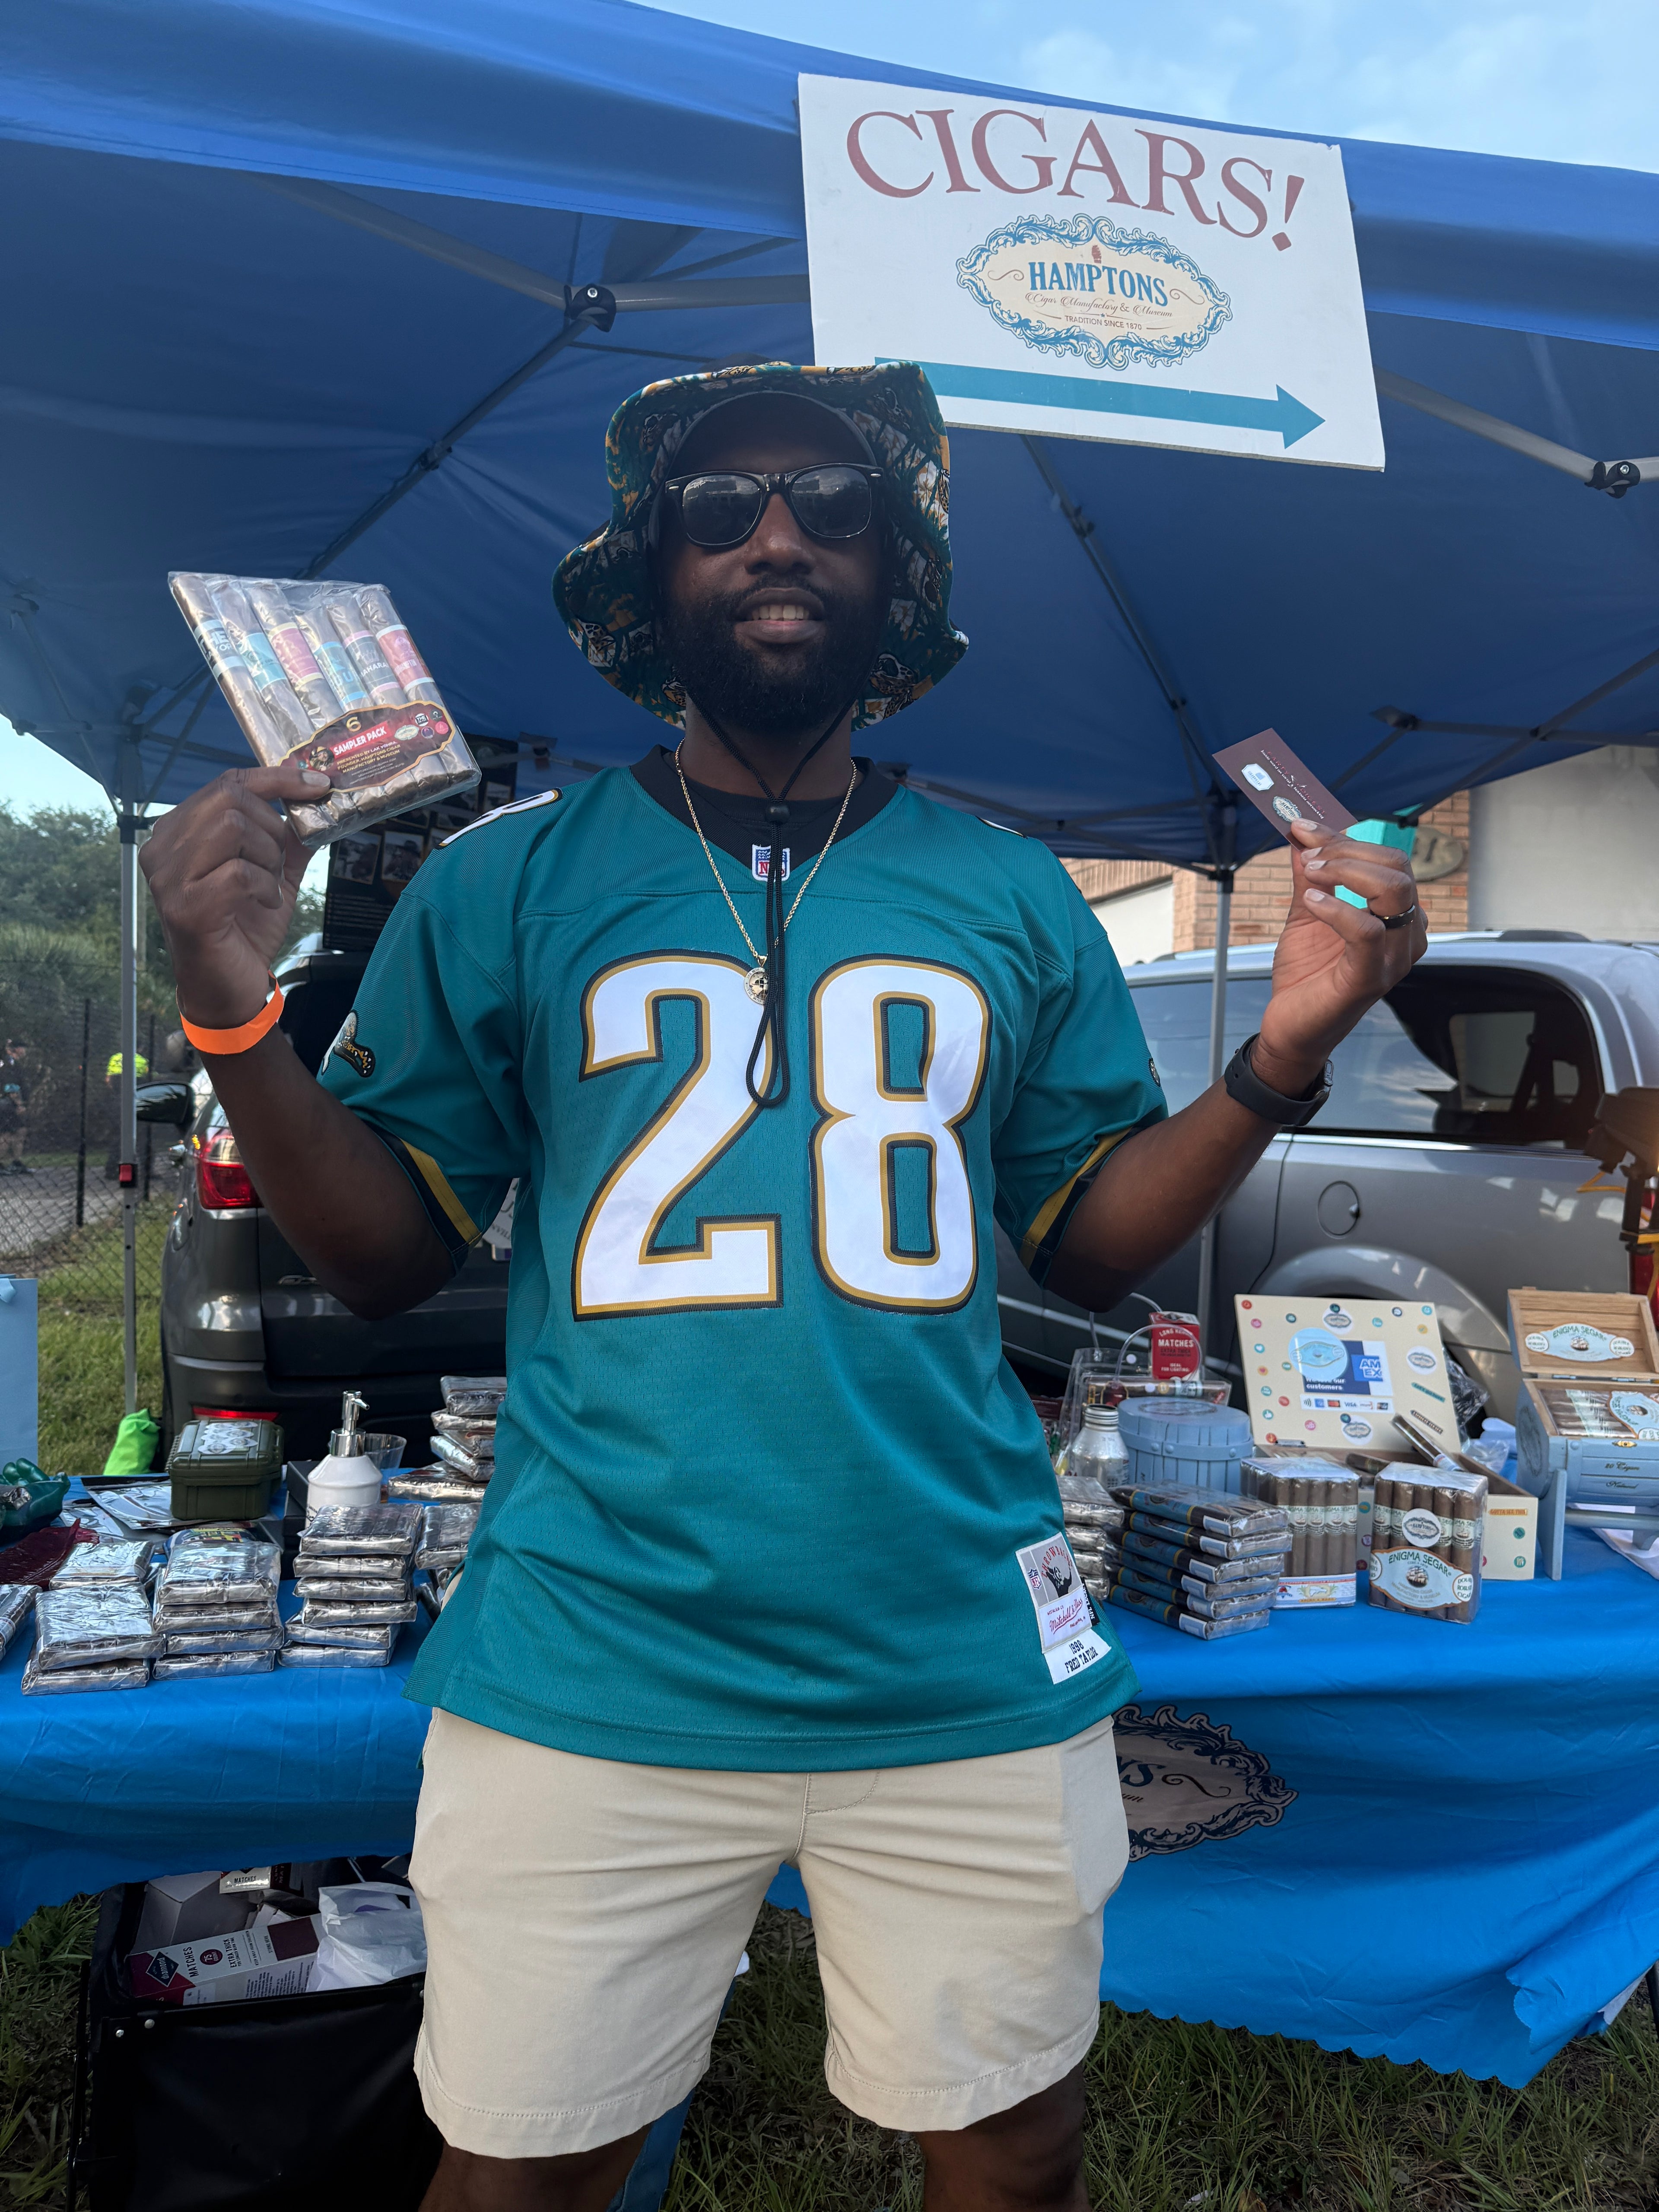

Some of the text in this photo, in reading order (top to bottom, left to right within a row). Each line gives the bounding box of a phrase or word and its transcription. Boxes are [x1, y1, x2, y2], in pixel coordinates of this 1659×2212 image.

[847, 108, 1305, 251] CIGARS!
[1028, 262, 1168, 307] HAMPTONS
[1025, 292, 1173, 317] Cigar Manufactory & Museum
[1065, 315, 1102, 325] TRADITION
[1104, 320, 1124, 328] SINCE
[346, 716, 361, 732] 6
[334, 726, 387, 756] SAMPLER PACK
[361, 749, 386, 761] HAMPTONS
[387, 744, 401, 753] CIGAR
[337, 752, 363, 764] PRESENTED
[343, 759, 376, 773] MANUFACTORY
[380, 750, 400, 759] MUSEUM
[570, 948, 993, 1322] 28
[1553, 1326, 1579, 1338] ENIGMA
[1389, 1551, 1448, 1577] ENIGMA SEGAR
[1031, 1576, 1041, 1587] NFL
[1050, 1606, 1071, 1632] Mitchell
[1069, 1640, 1084, 1654] 1998
[1065, 1646, 1098, 1673] FRED TAYLOR
[183, 1946, 199, 1977] MATCHES
[203, 1954, 213, 1962] 75
[223, 1938, 237, 1968] EXTRA THICK
[157, 1957, 169, 1979] diamond
